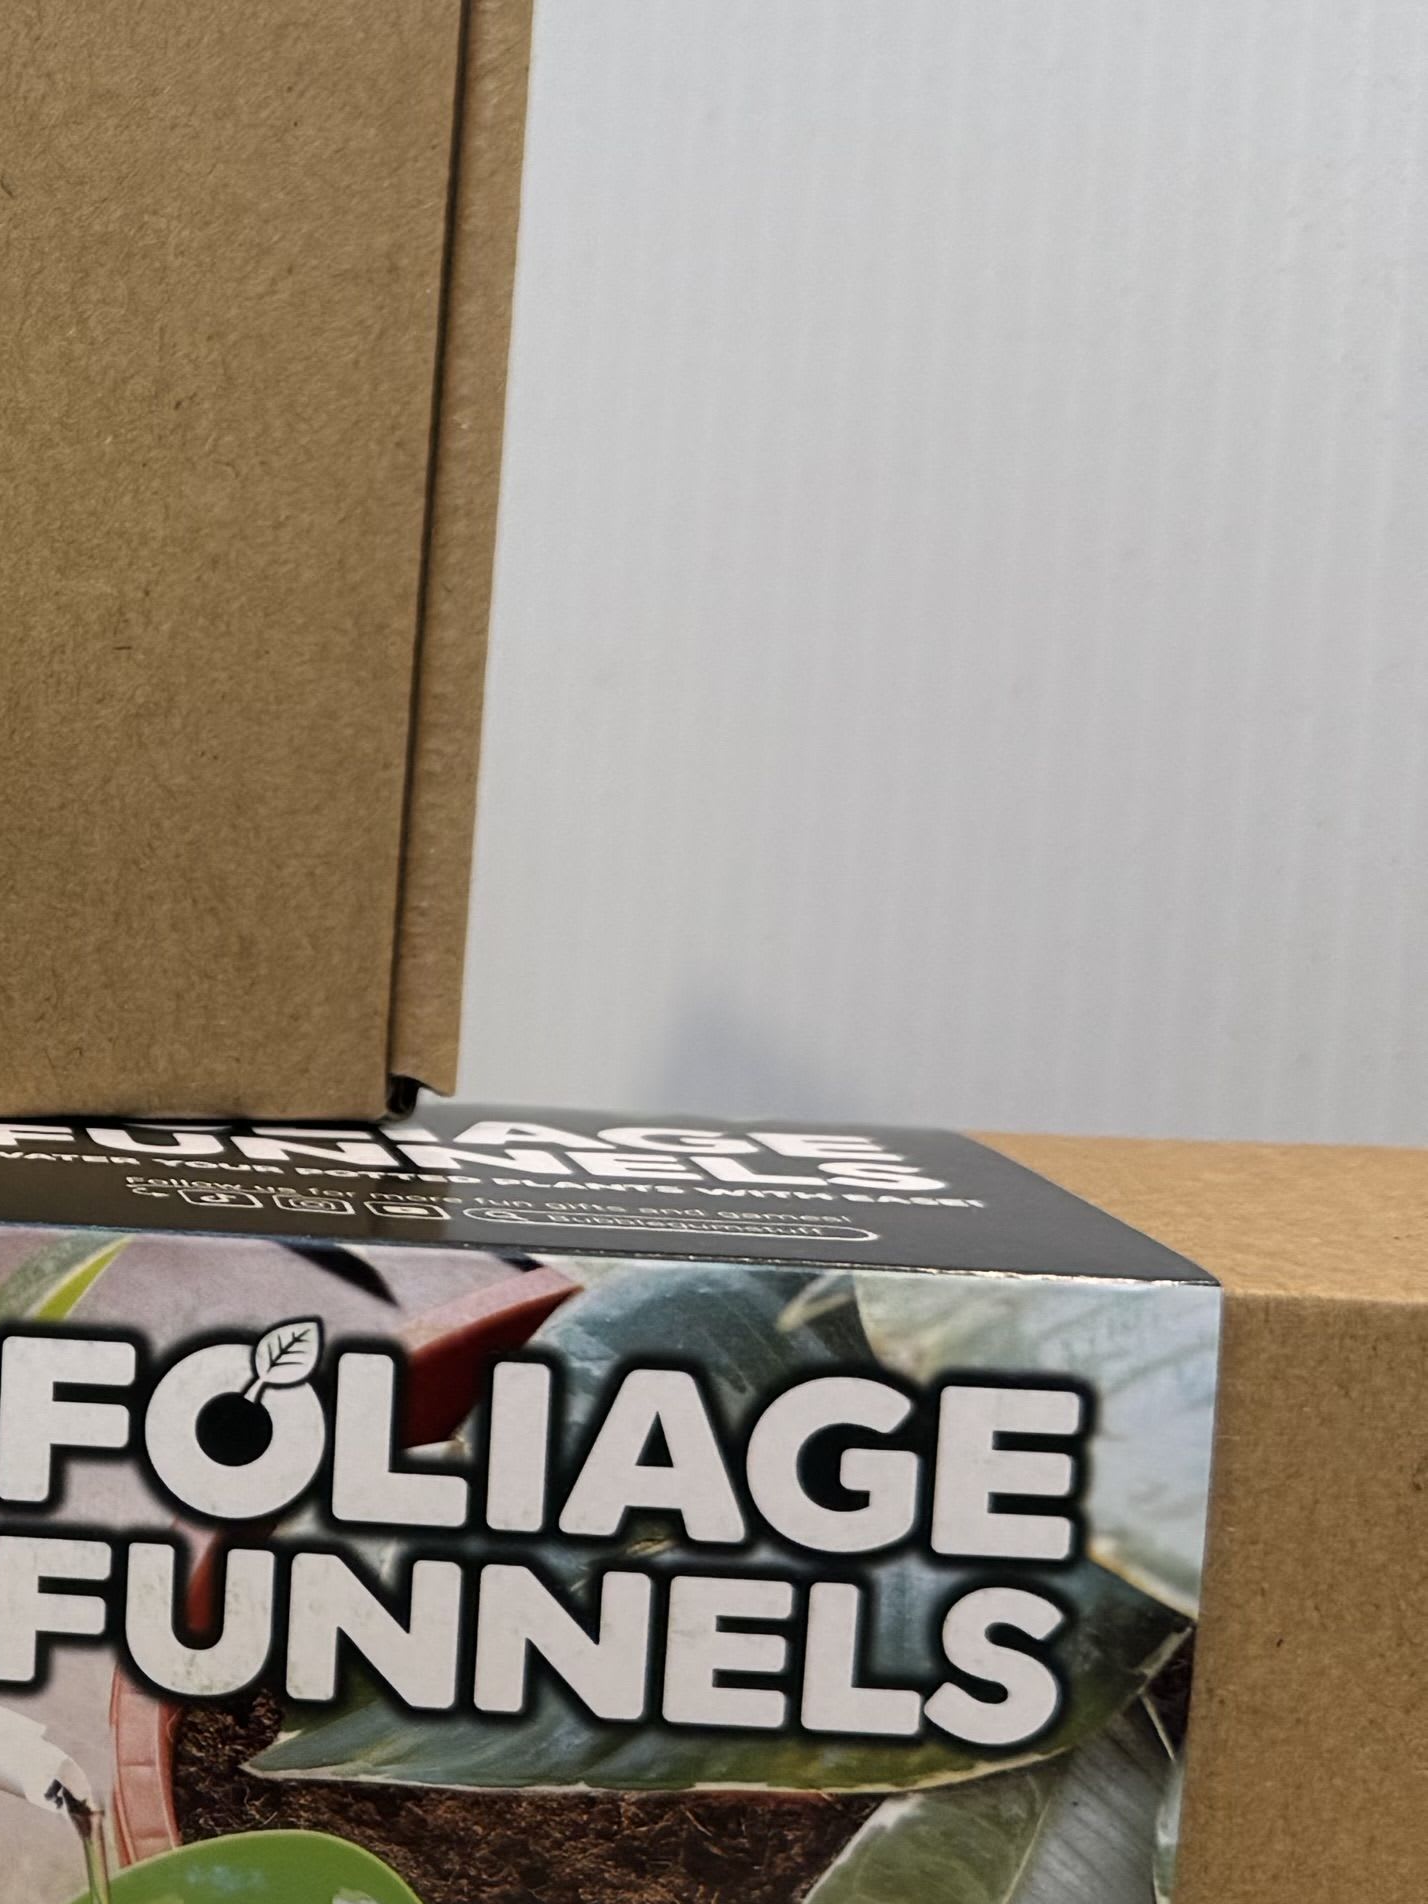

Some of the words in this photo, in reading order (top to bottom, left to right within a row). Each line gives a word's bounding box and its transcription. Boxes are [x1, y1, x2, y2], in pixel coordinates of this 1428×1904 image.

[125, 1175, 242, 1191] Follow
[308, 1187, 356, 1198] for
[369, 1191, 464, 1205] more
[474, 1197, 533, 1209] fun
[639, 1206, 705, 1217] and
[151, 1157, 285, 1175] YOUR
[294, 1167, 482, 1185] POTTED
[491, 1177, 686, 1195] PLANTS
[693, 1187, 834, 1202] WITH
[842, 1194, 987, 1209] EASE!
